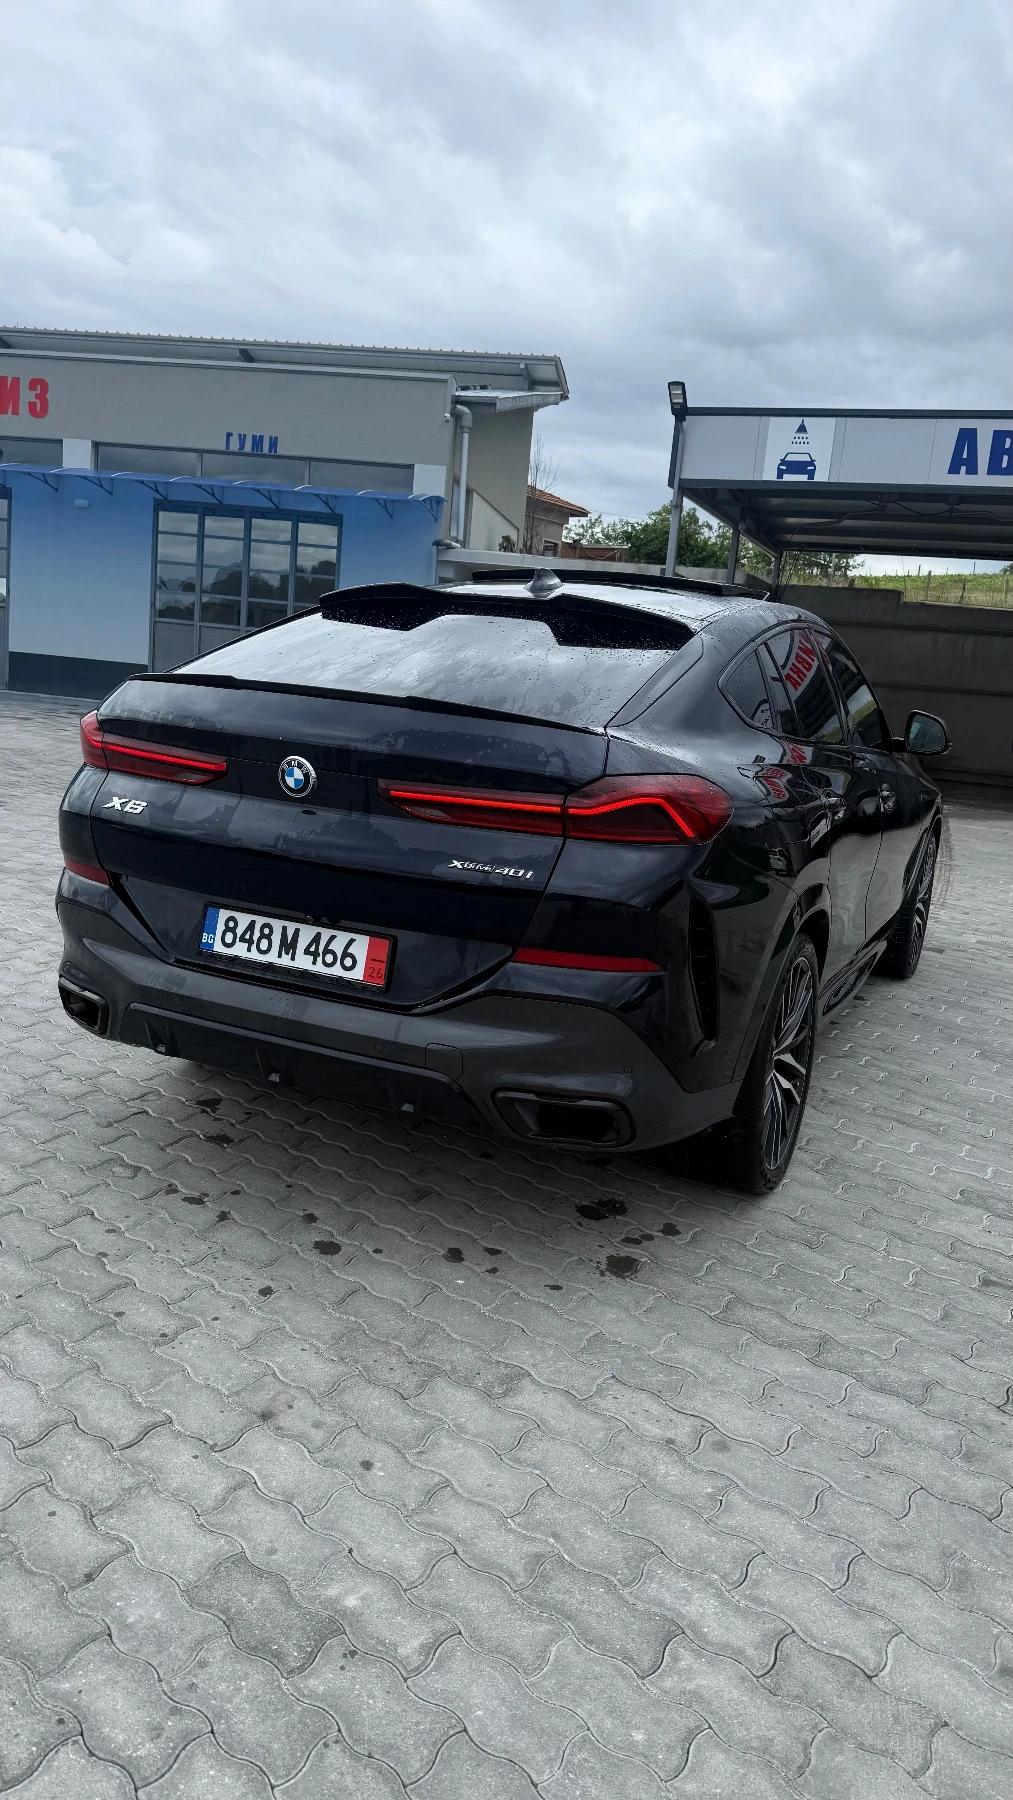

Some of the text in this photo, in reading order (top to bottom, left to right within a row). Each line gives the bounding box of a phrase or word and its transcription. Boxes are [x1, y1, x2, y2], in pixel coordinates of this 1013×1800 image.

[225, 432, 279, 454] ГУМИ
[102, 796, 148, 814] X6
[202, 932, 215, 944] BG
[367, 965, 384, 979] 26
